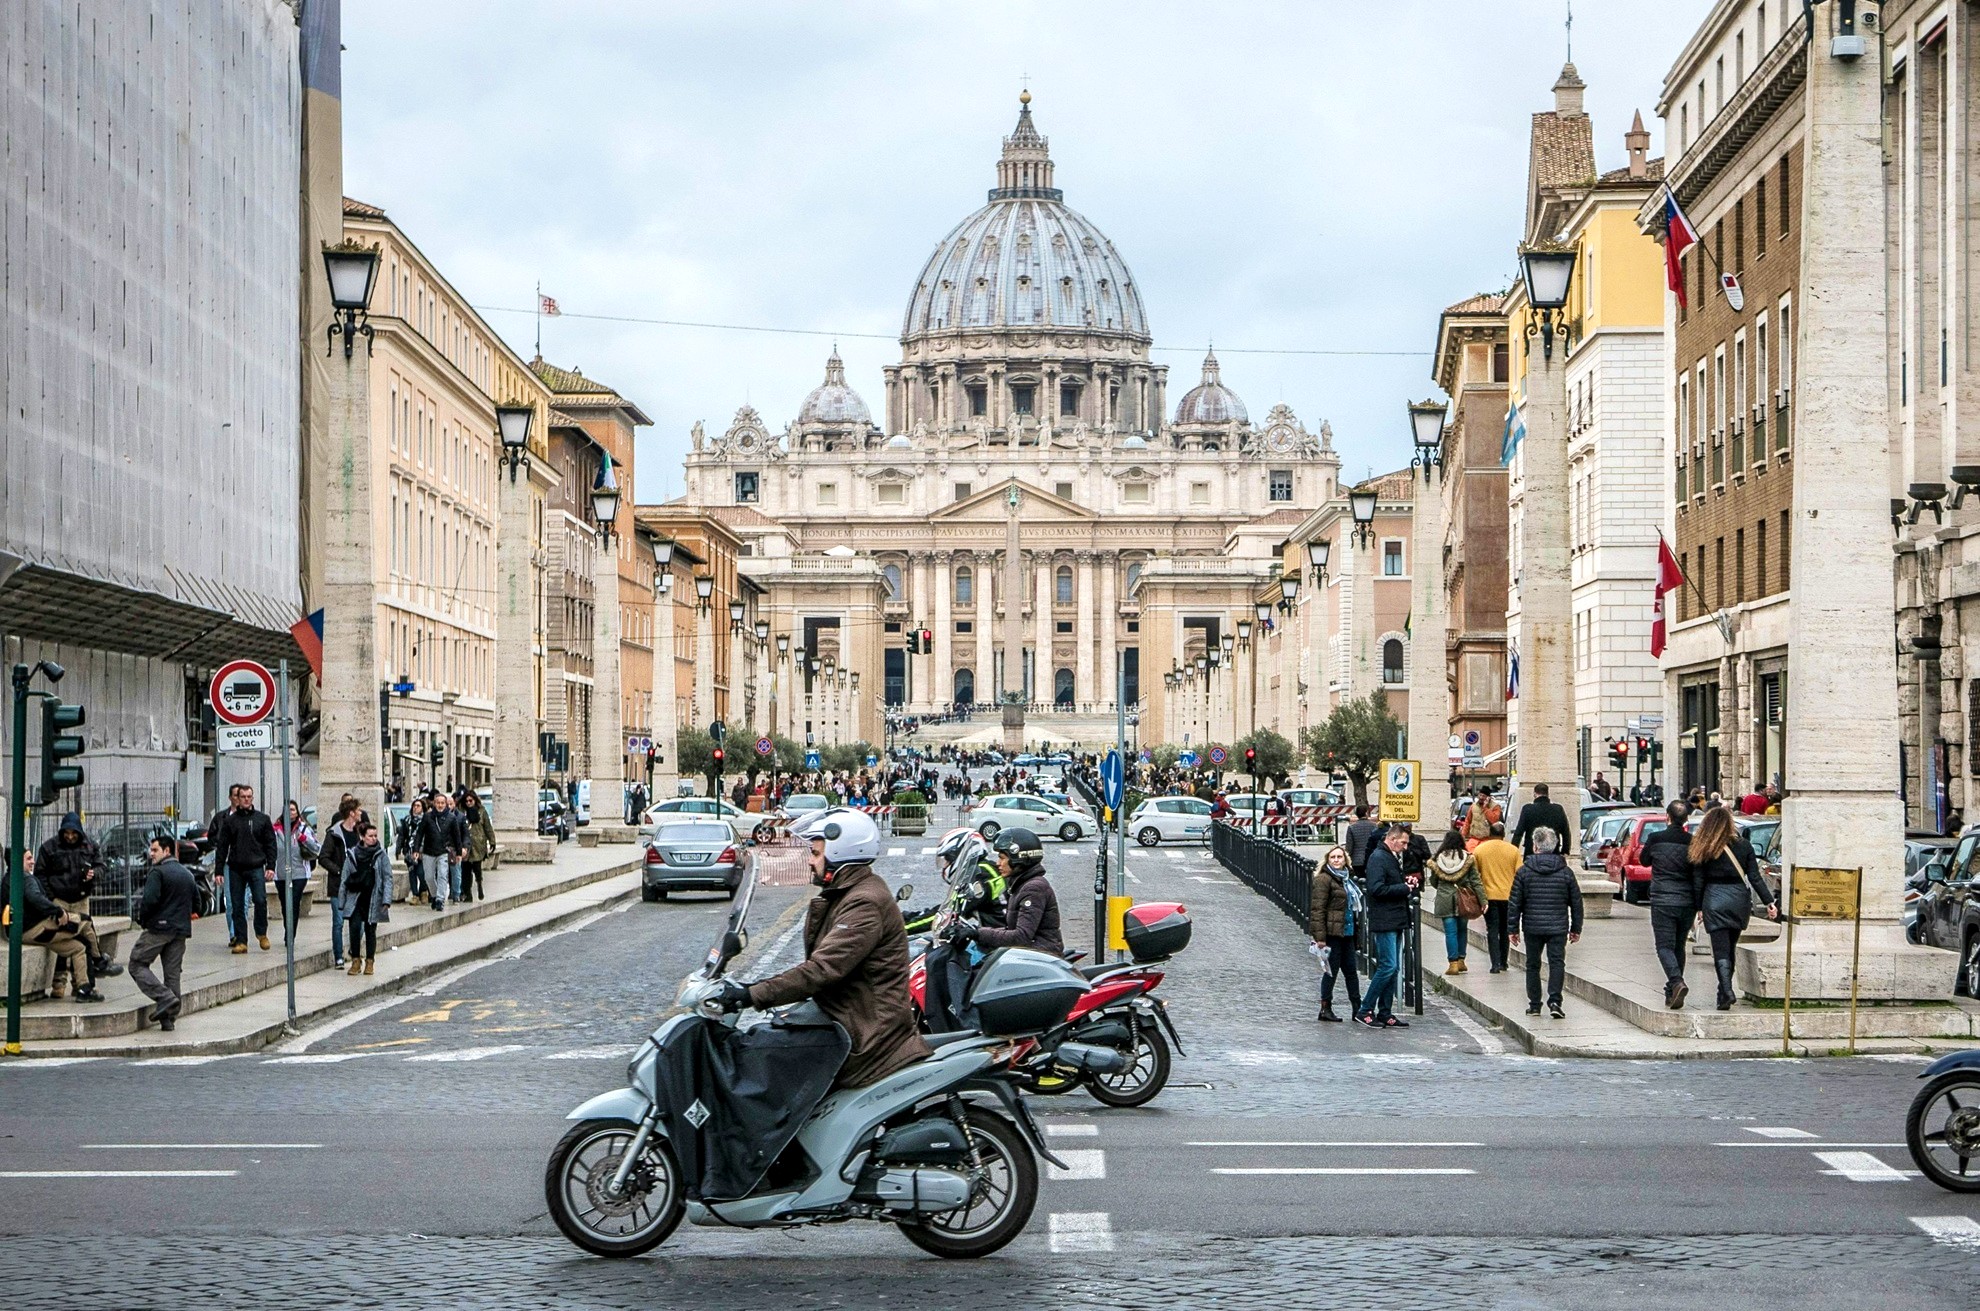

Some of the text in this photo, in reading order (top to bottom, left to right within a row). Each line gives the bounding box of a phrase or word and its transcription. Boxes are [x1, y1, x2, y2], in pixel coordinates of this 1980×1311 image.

[801, 529, 852, 537] HONOREM
[854, 529, 904, 537] PRINCIPIS
[936, 528, 969, 536] PAVLVS
[1042, 528, 1092, 536] ROMANVS
[1093, 528, 1119, 536] PONT
[1119, 528, 1141, 536] MAX
[235, 702, 241, 710] 6
[226, 728, 263, 738] eccetto
[234, 739, 256, 748] atac
